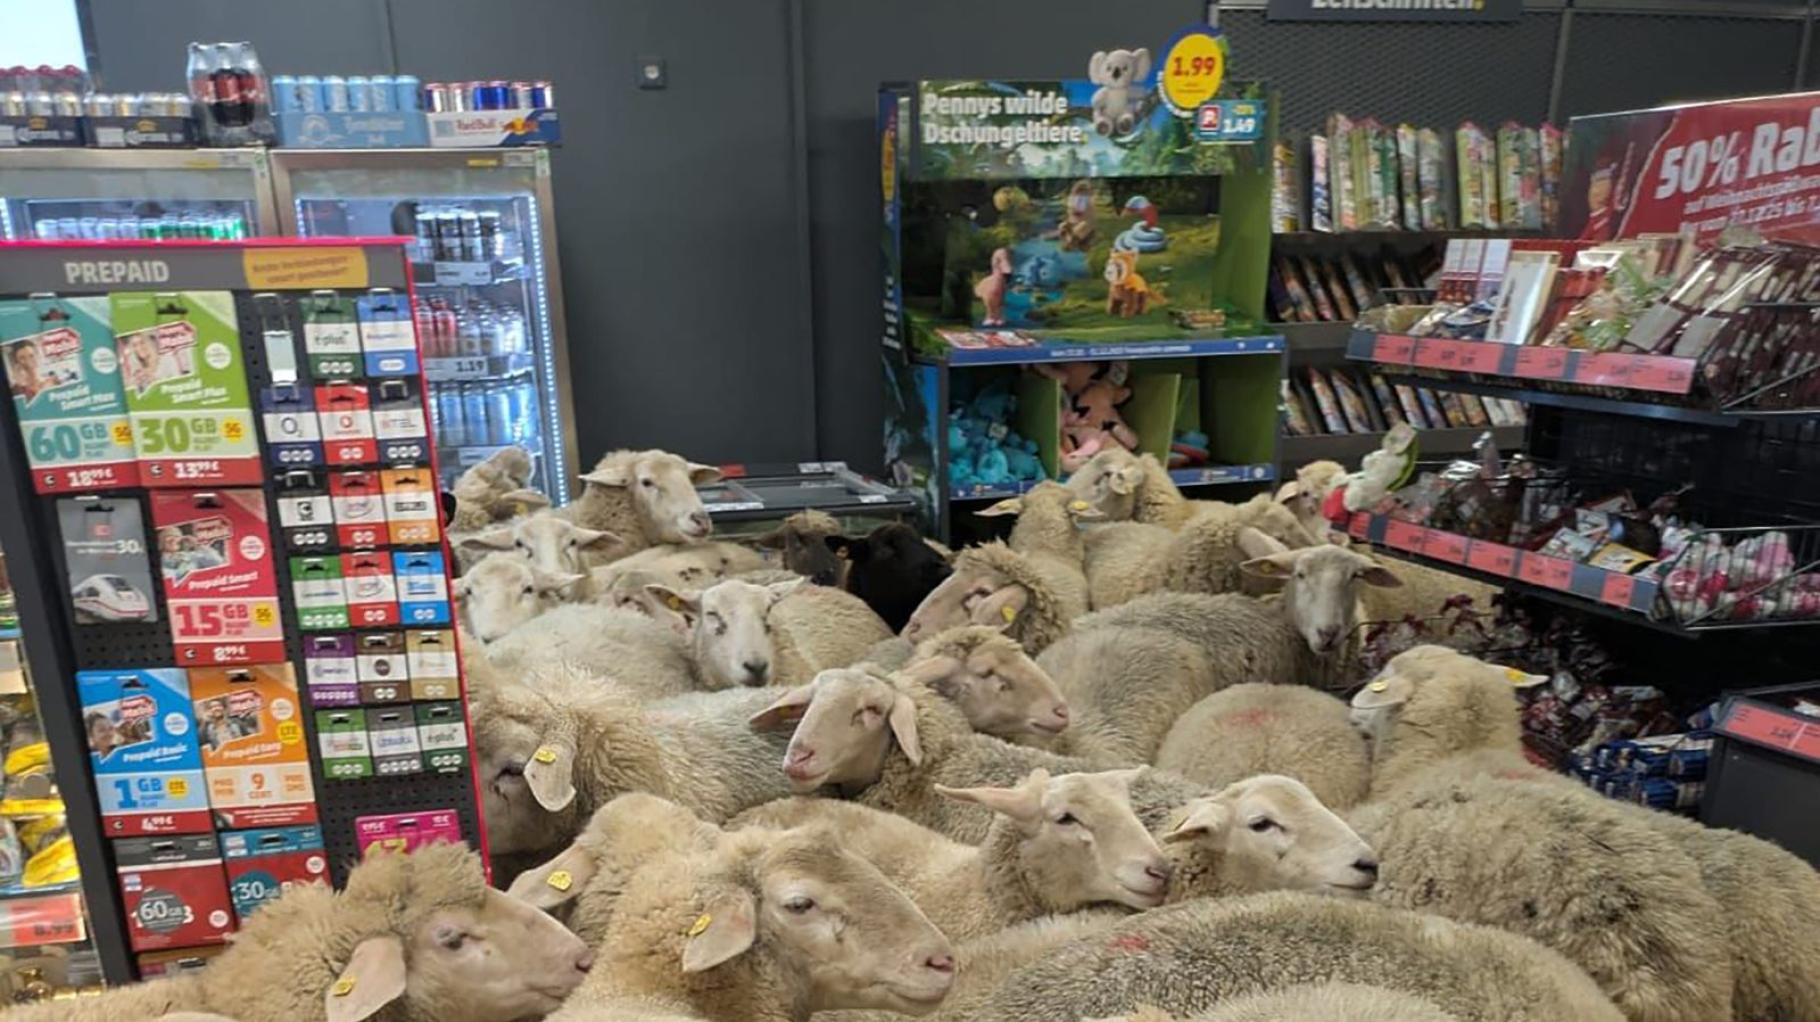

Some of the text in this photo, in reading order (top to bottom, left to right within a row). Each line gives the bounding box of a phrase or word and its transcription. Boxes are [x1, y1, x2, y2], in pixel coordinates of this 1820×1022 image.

[1172, 56, 1216, 77] 1.99
[922, 88, 1068, 120] Pennys wilde
[924, 118, 1089, 148] Dschungeltiere.
[1654, 131, 1743, 200] 50%
[64, 260, 170, 284] PREPAID
[30, 424, 82, 462] 60
[80, 423, 109, 441] GB
[138, 417, 191, 454] 30
[191, 418, 217, 434] GB
[188, 573, 227, 591] Prepaid
[174, 604, 223, 637] 15
[223, 603, 249, 619] GB
[114, 778, 138, 809] 1
[137, 778, 163, 793] GB
[250, 772, 265, 790] 9
[236, 881, 265, 900] 30
[140, 900, 168, 921] 60
